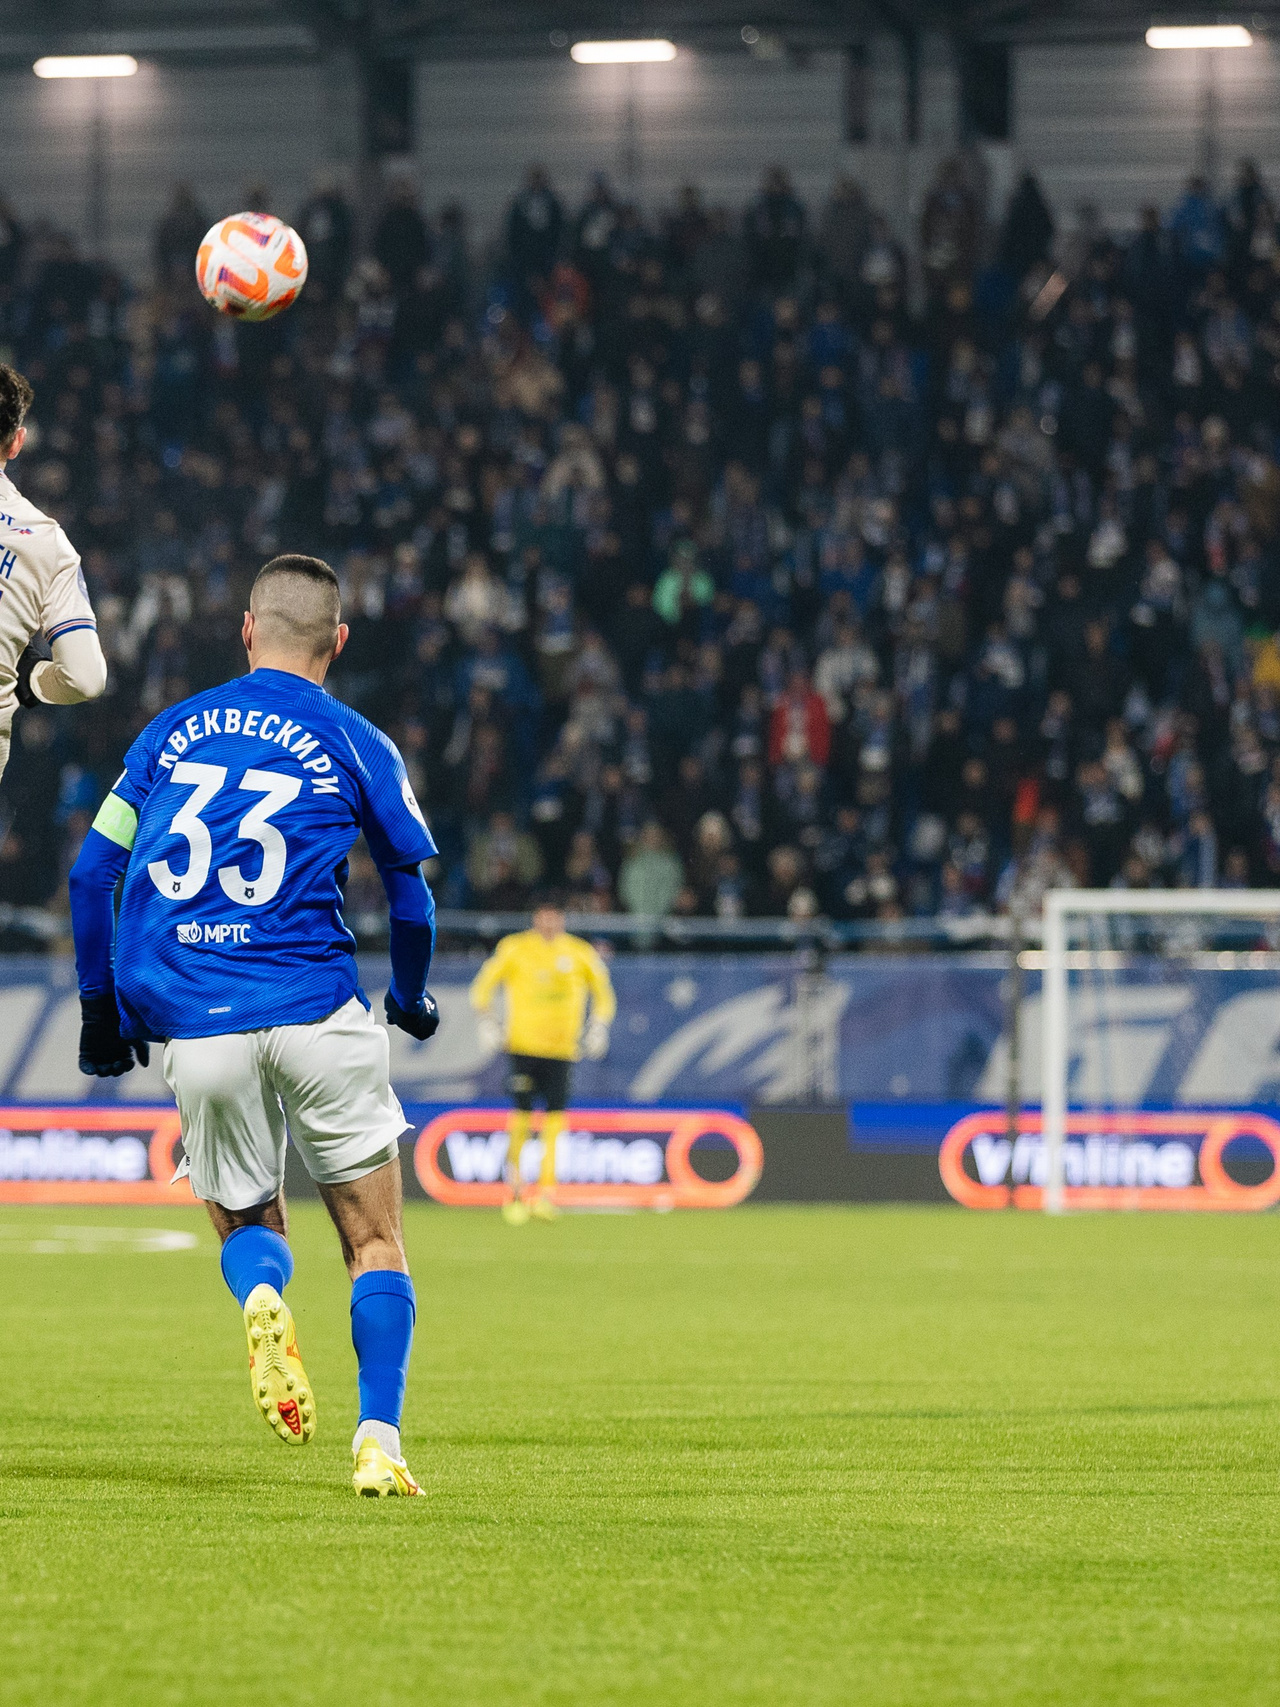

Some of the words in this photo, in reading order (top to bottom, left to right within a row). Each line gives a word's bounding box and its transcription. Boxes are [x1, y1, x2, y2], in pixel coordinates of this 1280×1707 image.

[158, 708, 340, 795] КВЕКВЕСКИРИ
[147, 761, 304, 906] 33
[204, 923, 252, 944] МРТС
